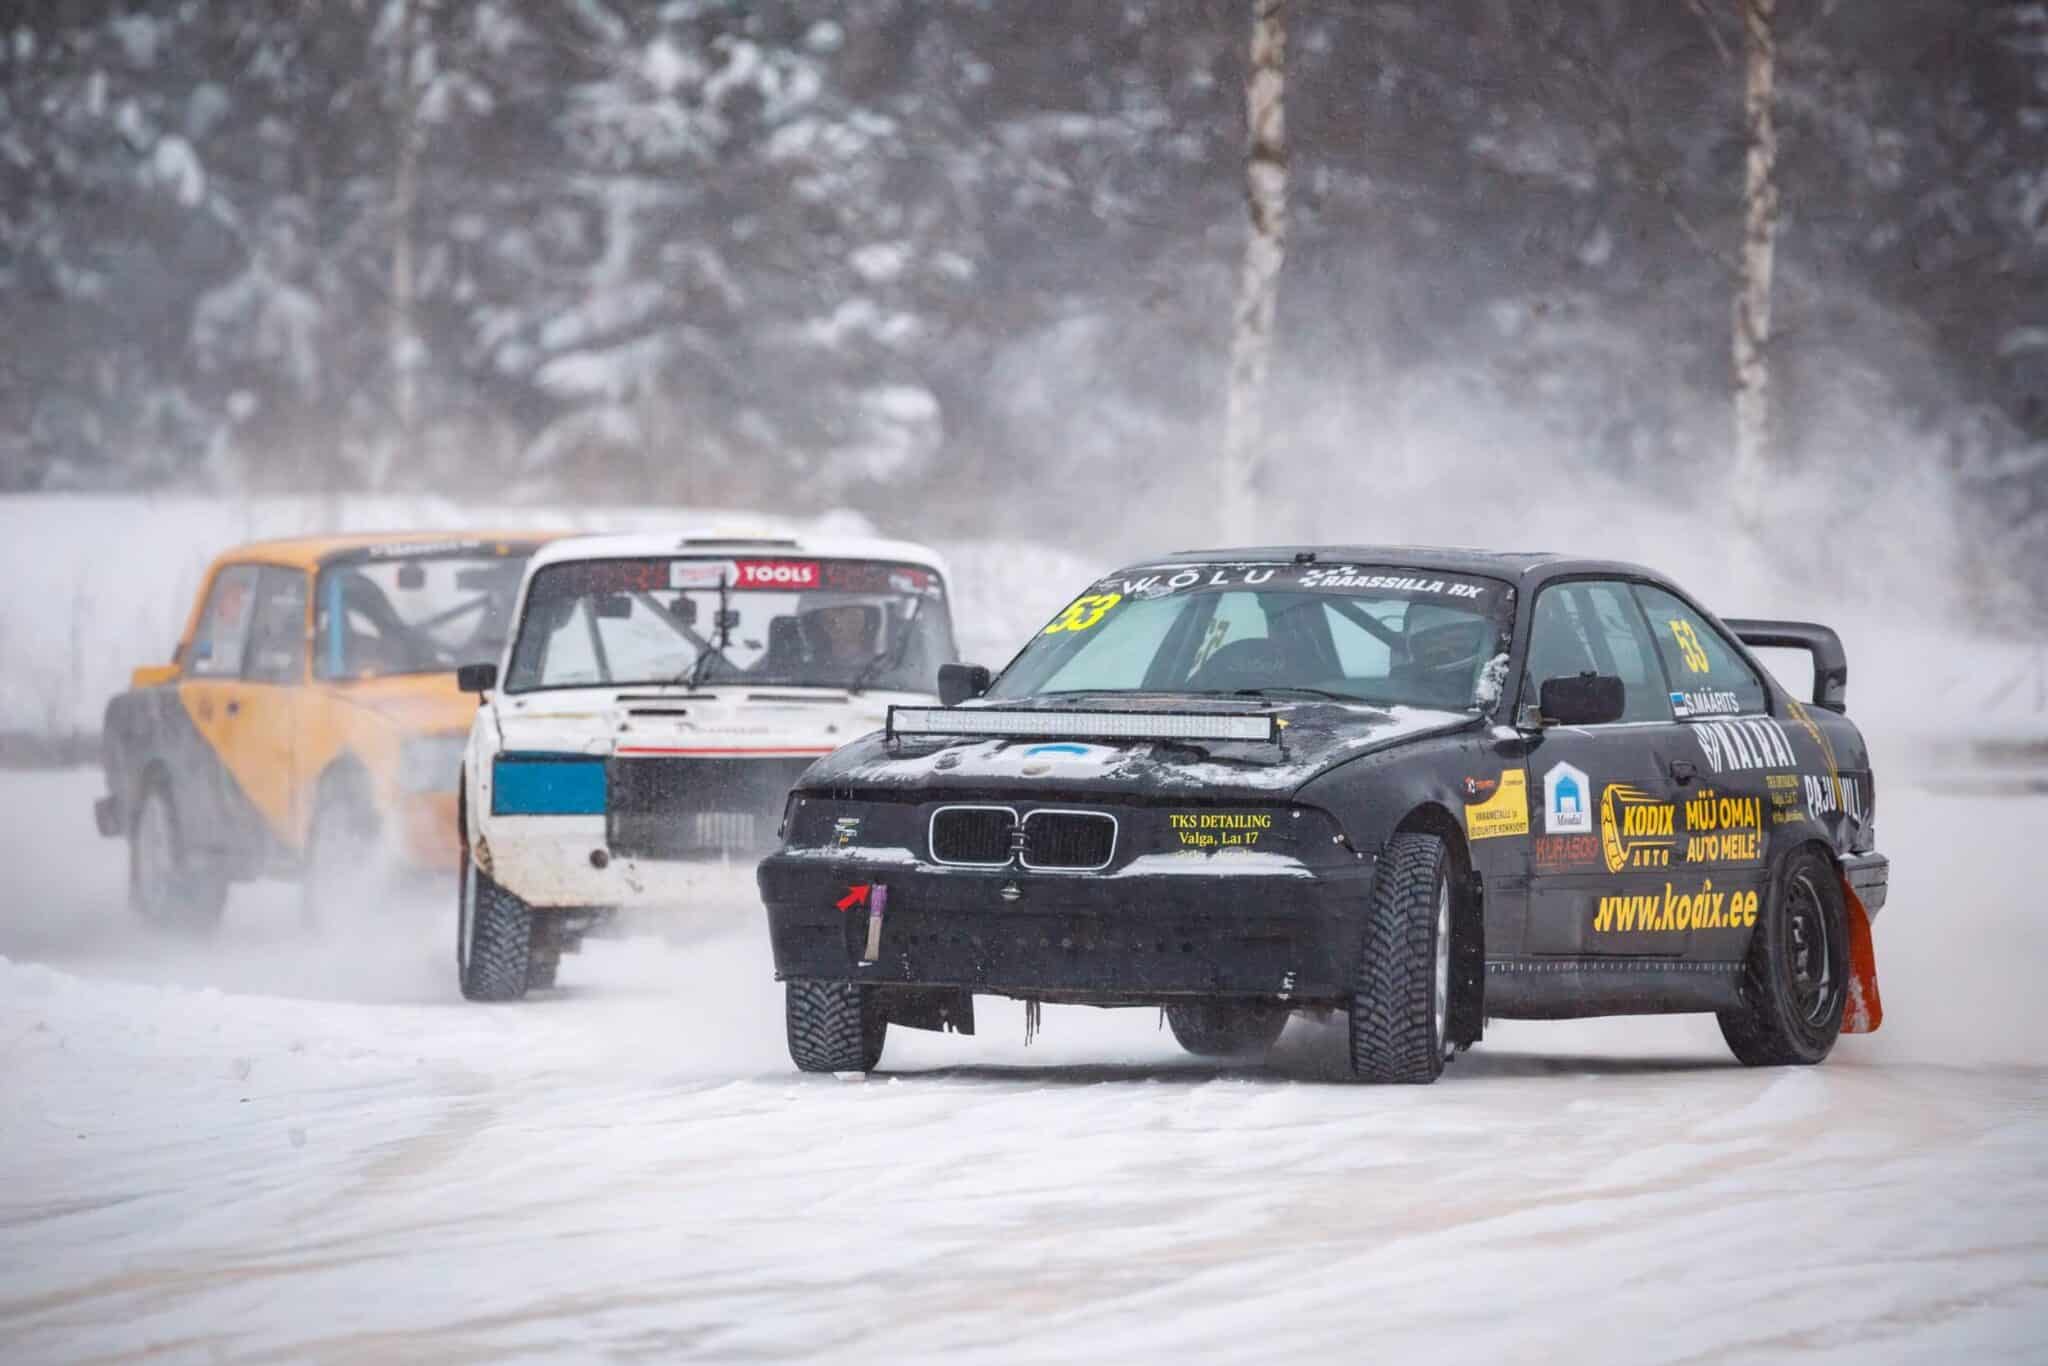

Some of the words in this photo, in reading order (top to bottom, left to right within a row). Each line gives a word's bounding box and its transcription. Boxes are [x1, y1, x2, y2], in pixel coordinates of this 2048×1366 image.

[743, 565, 813, 583] TOOLS
[1121, 568, 1275, 595] WÕLU
[1319, 575, 1446, 593] RAASSILLA
[1446, 583, 1486, 598] RX
[1045, 592, 1123, 634] 53
[1669, 619, 1710, 673] 53
[1685, 687, 1740, 714] S.MÄÄRITS
[1169, 814, 1198, 828] TKS
[1200, 814, 1272, 828] DETAILING
[1623, 804, 1676, 837] KODIX
[1719, 797, 1755, 829] OMA
[1179, 831, 1219, 848] Valga,
[1244, 831, 1259, 845] 17
[1686, 834, 1719, 862] AUTO
[1632, 849, 1669, 866] AUTO
[1594, 879, 1759, 932] www.kodix.ee
